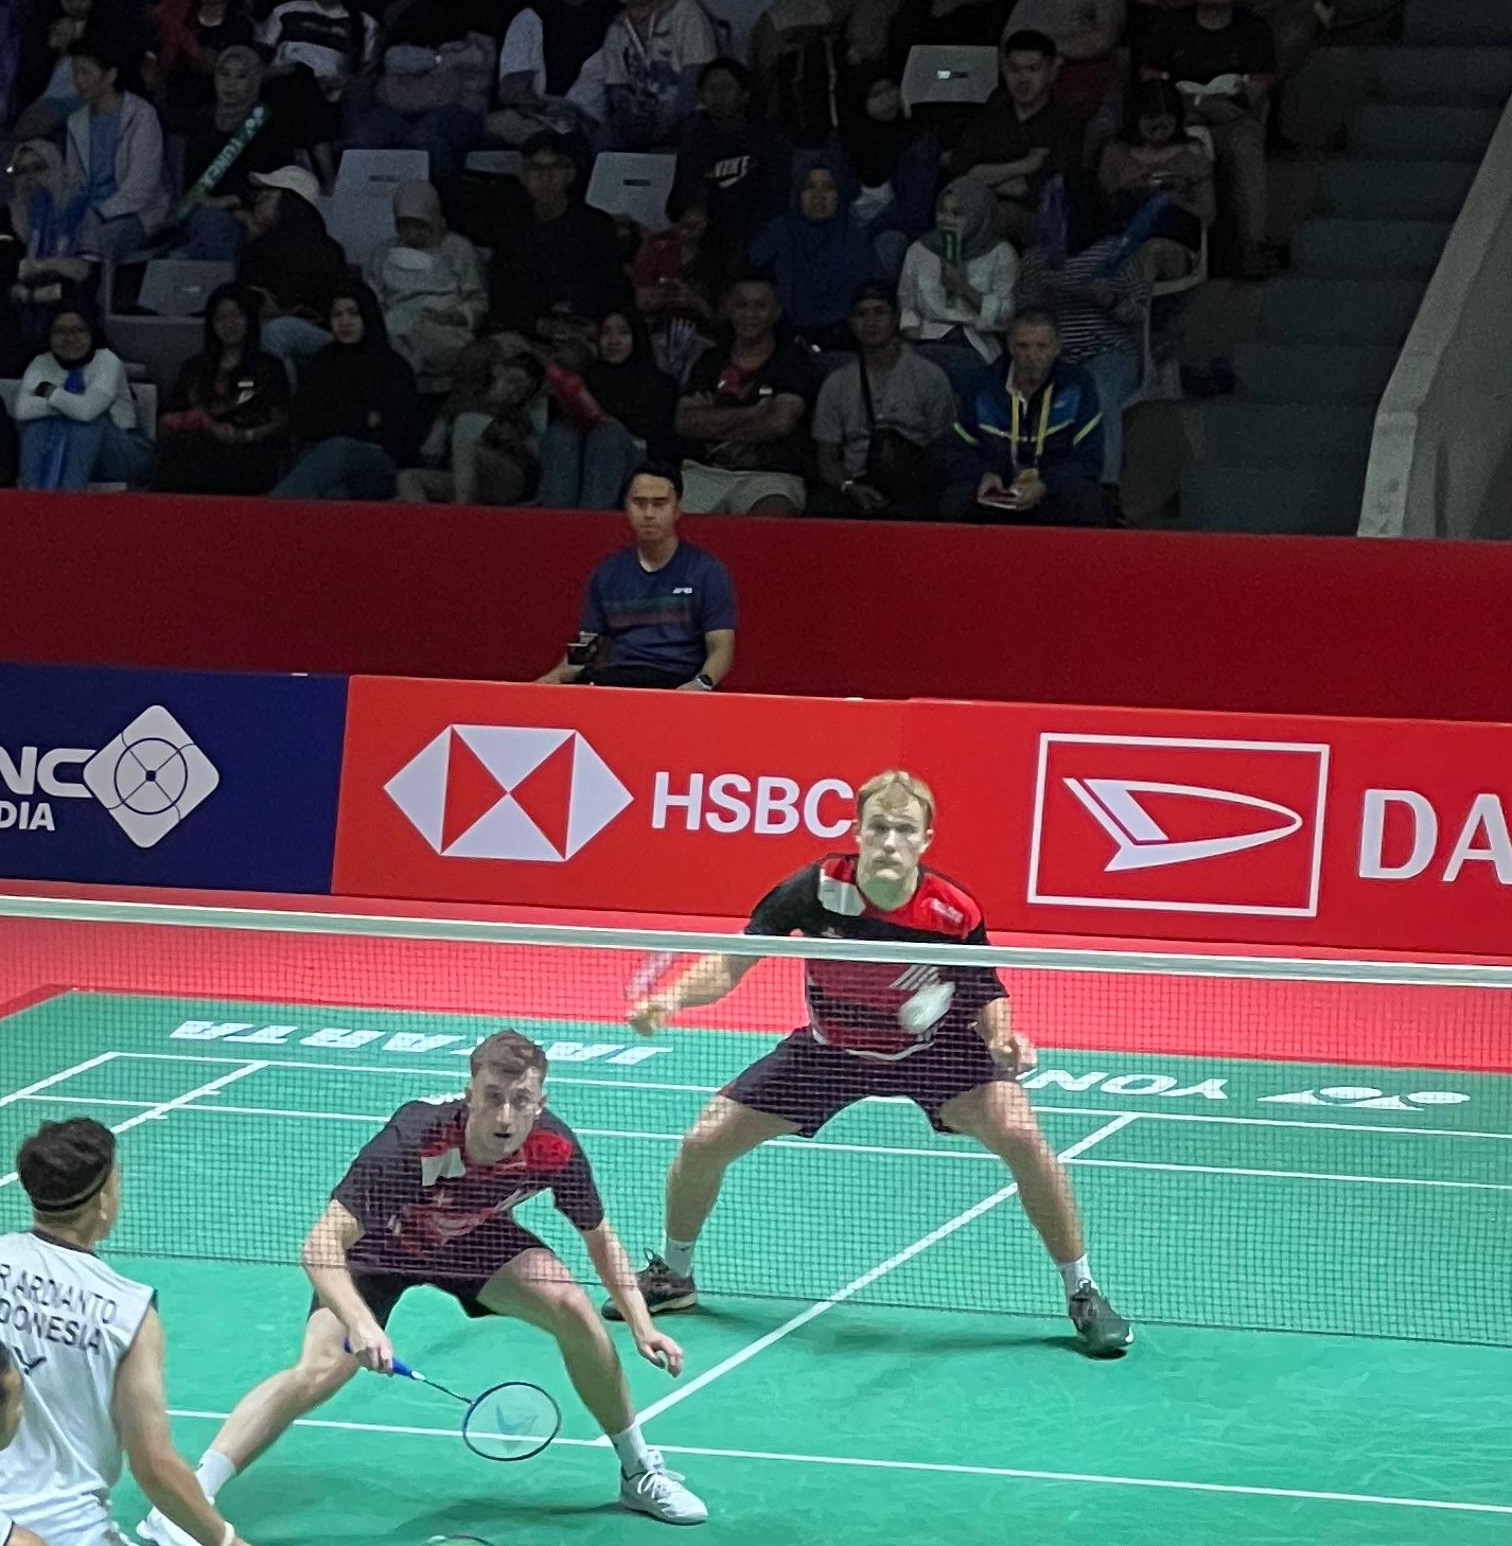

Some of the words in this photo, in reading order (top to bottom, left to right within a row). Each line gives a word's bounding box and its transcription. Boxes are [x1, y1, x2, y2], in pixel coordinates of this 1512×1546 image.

[651, 770, 855, 838] HSBC
[169, 1020, 673, 1065] JAARTA
[1016, 1068, 1229, 1100] YON
[12, 1269, 118, 1324] ARDIANTO
